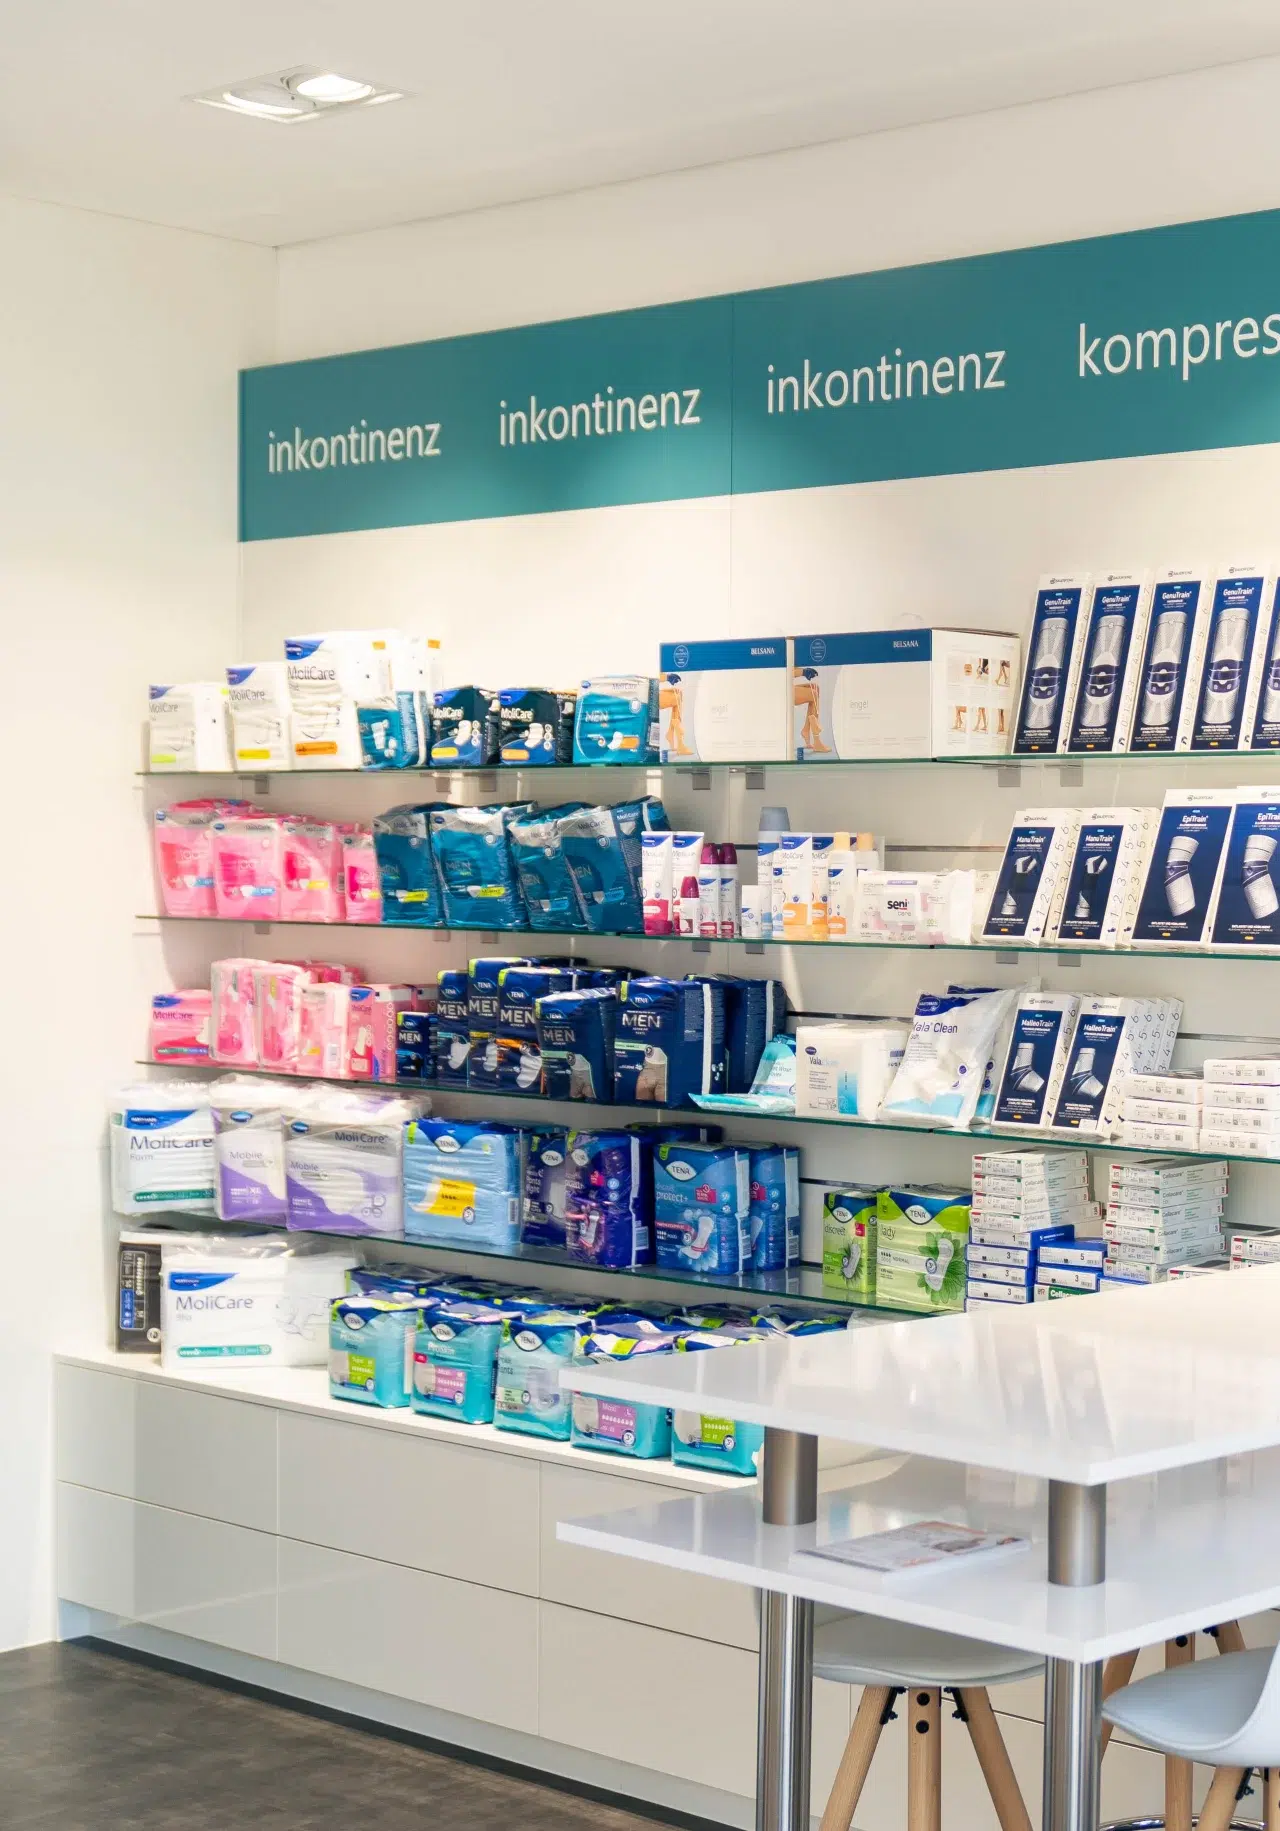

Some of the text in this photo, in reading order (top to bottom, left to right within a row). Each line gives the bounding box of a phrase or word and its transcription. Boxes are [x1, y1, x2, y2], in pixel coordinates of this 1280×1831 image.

[766, 347, 1007, 414] inkontinenz
[499, 386, 702, 447] inkontinenz
[267, 418, 442, 475] inkontinenz
[893, 640, 919, 648] BELSANA
[751, 646, 776, 655] BELSANA
[287, 666, 336, 681] MoliCare
[228, 688, 266, 700] MoliCare
[500, 706, 534, 721] MoliCare
[887, 898, 908, 910] seni
[437, 1004, 467, 1016] MEN
[500, 1010, 535, 1024] MEN
[622, 1013, 661, 1028] MEN
[933, 1022, 958, 1033] Clean
[399, 1032, 421, 1042] MEN
[543, 1029, 576, 1042] MEN
[809, 1057, 822, 1065] Vala
[130, 1135, 213, 1150] MoliCare
[335, 1131, 386, 1144] MoliCare
[130, 1153, 154, 1161] Form
[229, 1151, 263, 1159] Mobile
[290, 1161, 319, 1171] Mobile
[671, 1165, 690, 1175] TENA
[656, 1191, 689, 1203] protect+
[910, 1209, 927, 1219] TENA
[824, 1224, 846, 1236] discreet
[881, 1226, 896, 1240] lady
[175, 1296, 254, 1310] MoliCare
